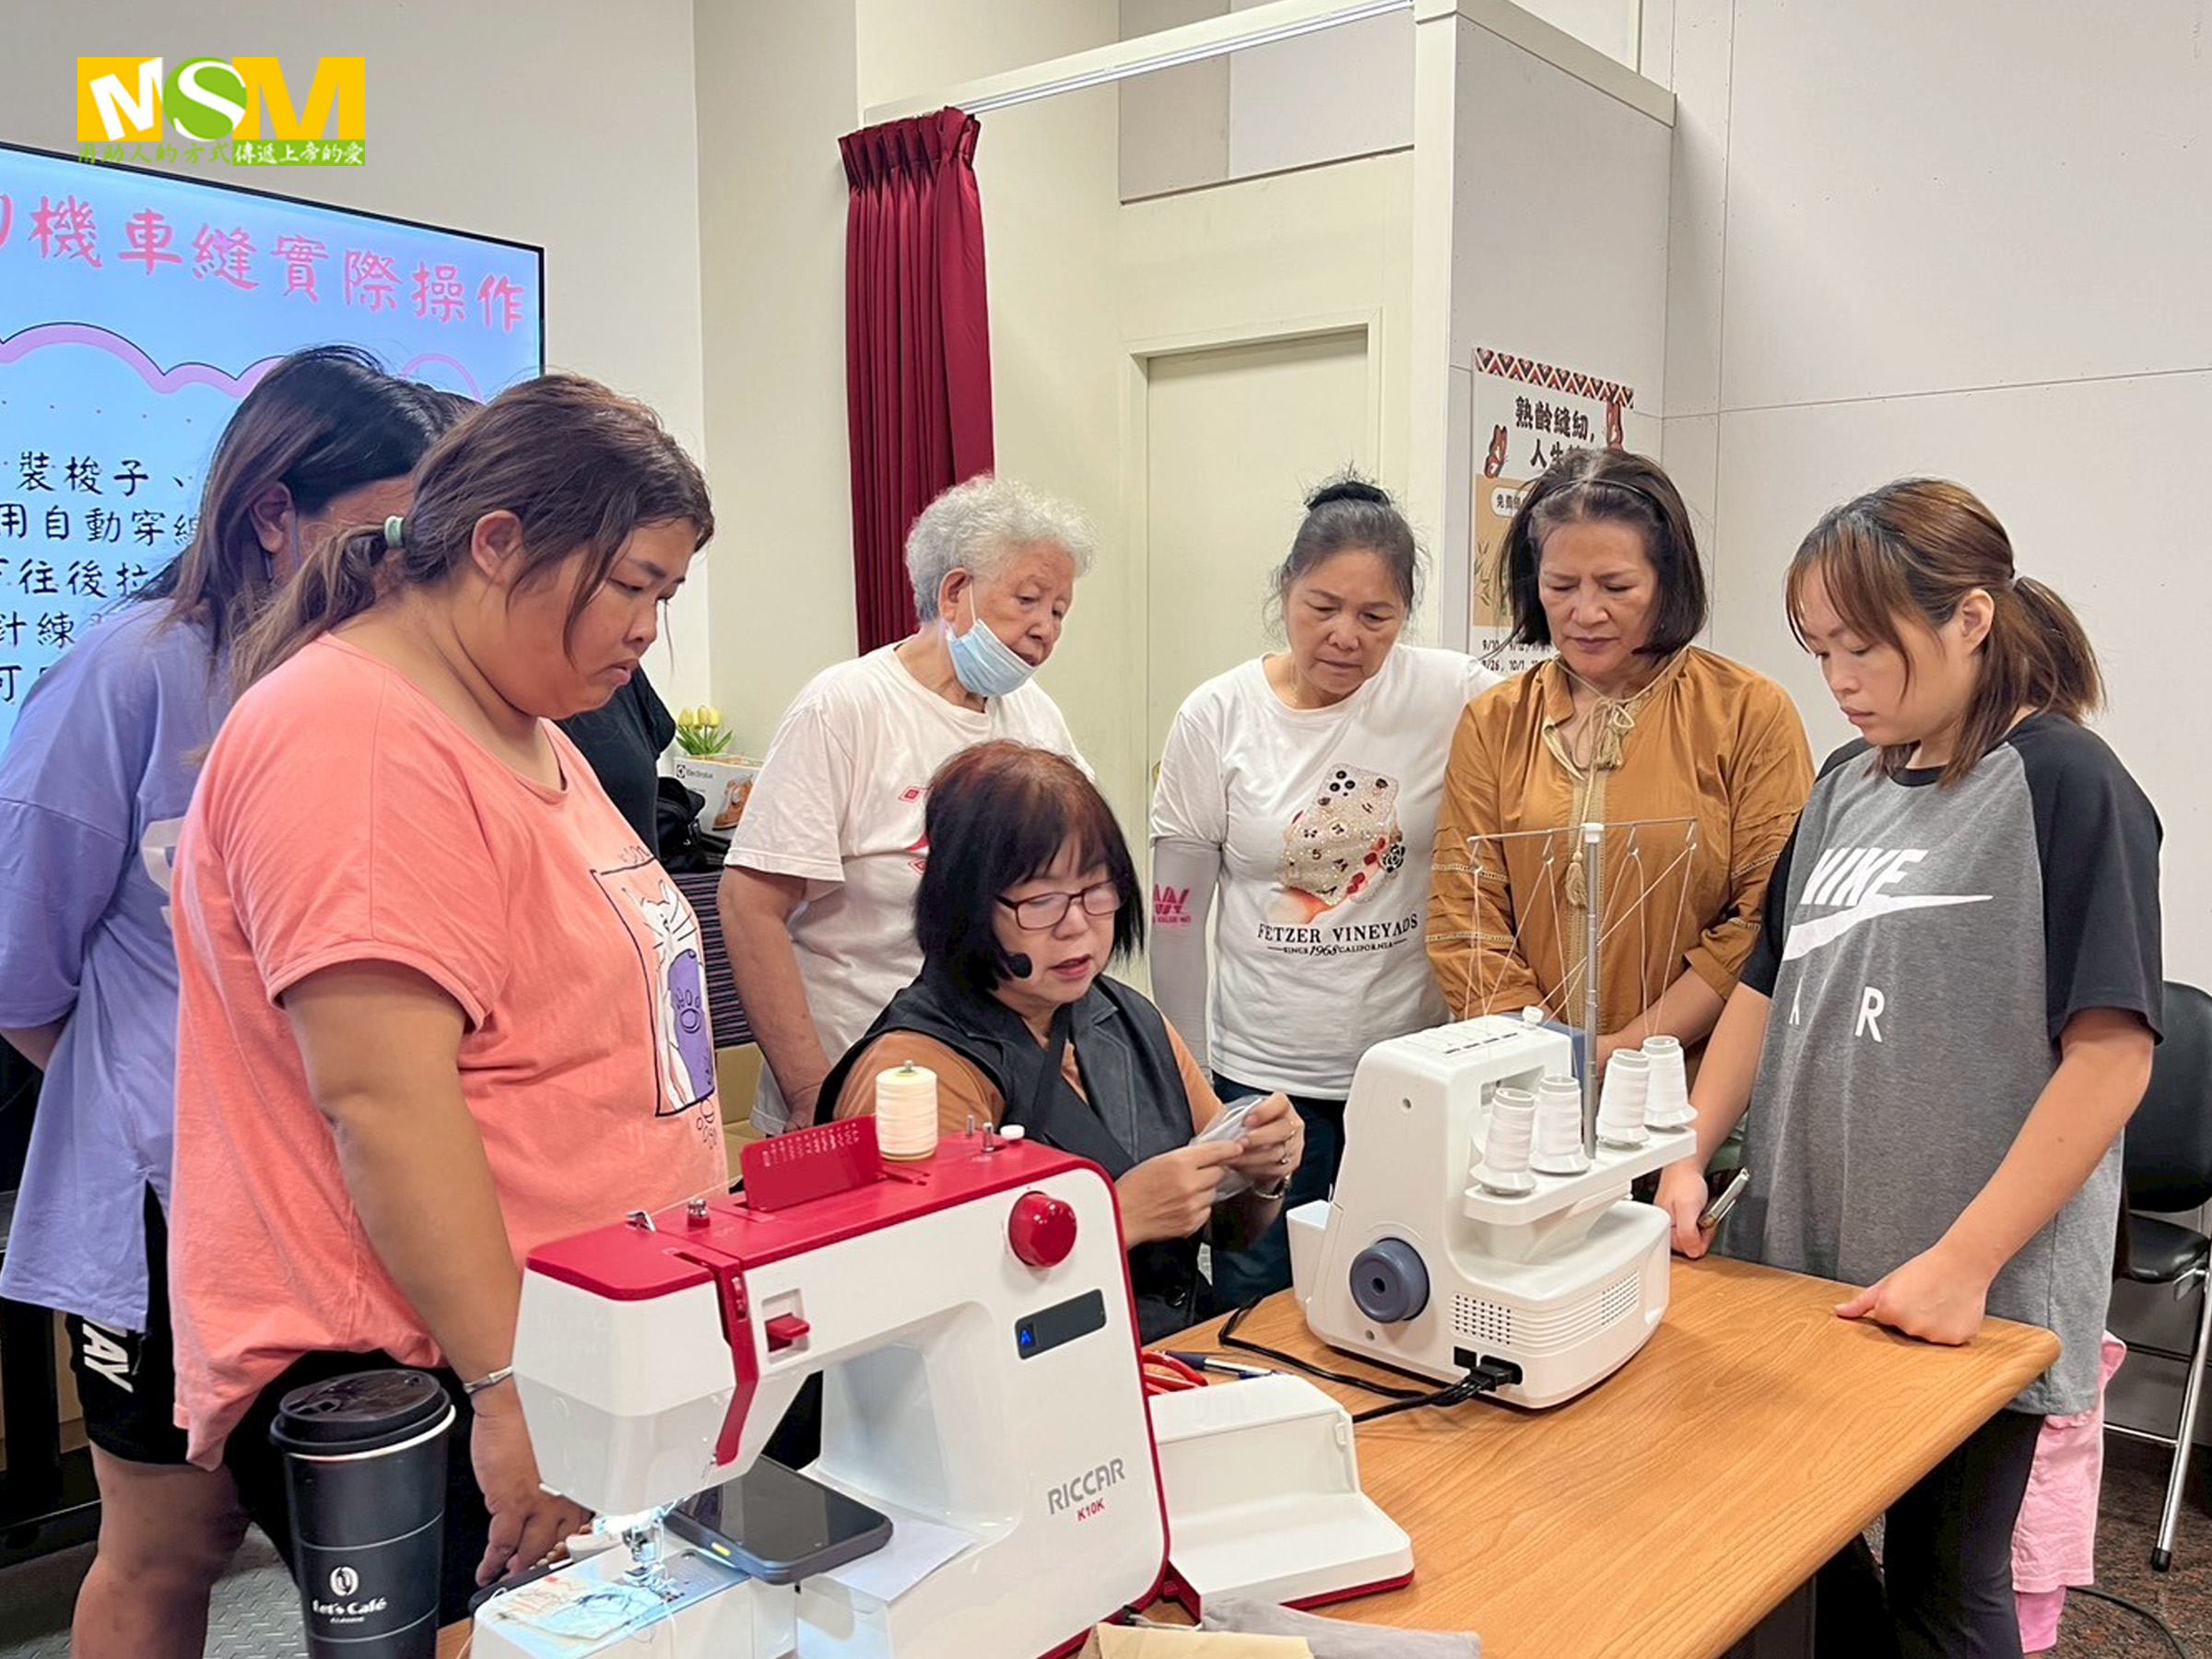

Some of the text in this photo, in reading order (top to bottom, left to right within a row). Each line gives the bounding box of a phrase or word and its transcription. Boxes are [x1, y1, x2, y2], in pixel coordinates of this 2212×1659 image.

[0, 194, 526, 334] 機車縫實際操作
[0, 558, 149, 599] 往後拉
[1800, 848, 1929, 907] NIKE
[1257, 912, 1418, 944] FETZER VINEYADS
[1046, 1457, 1126, 1515] RICCAR
[1077, 1498, 1106, 1522] K10K
[312, 1599, 346, 1616] Let's
